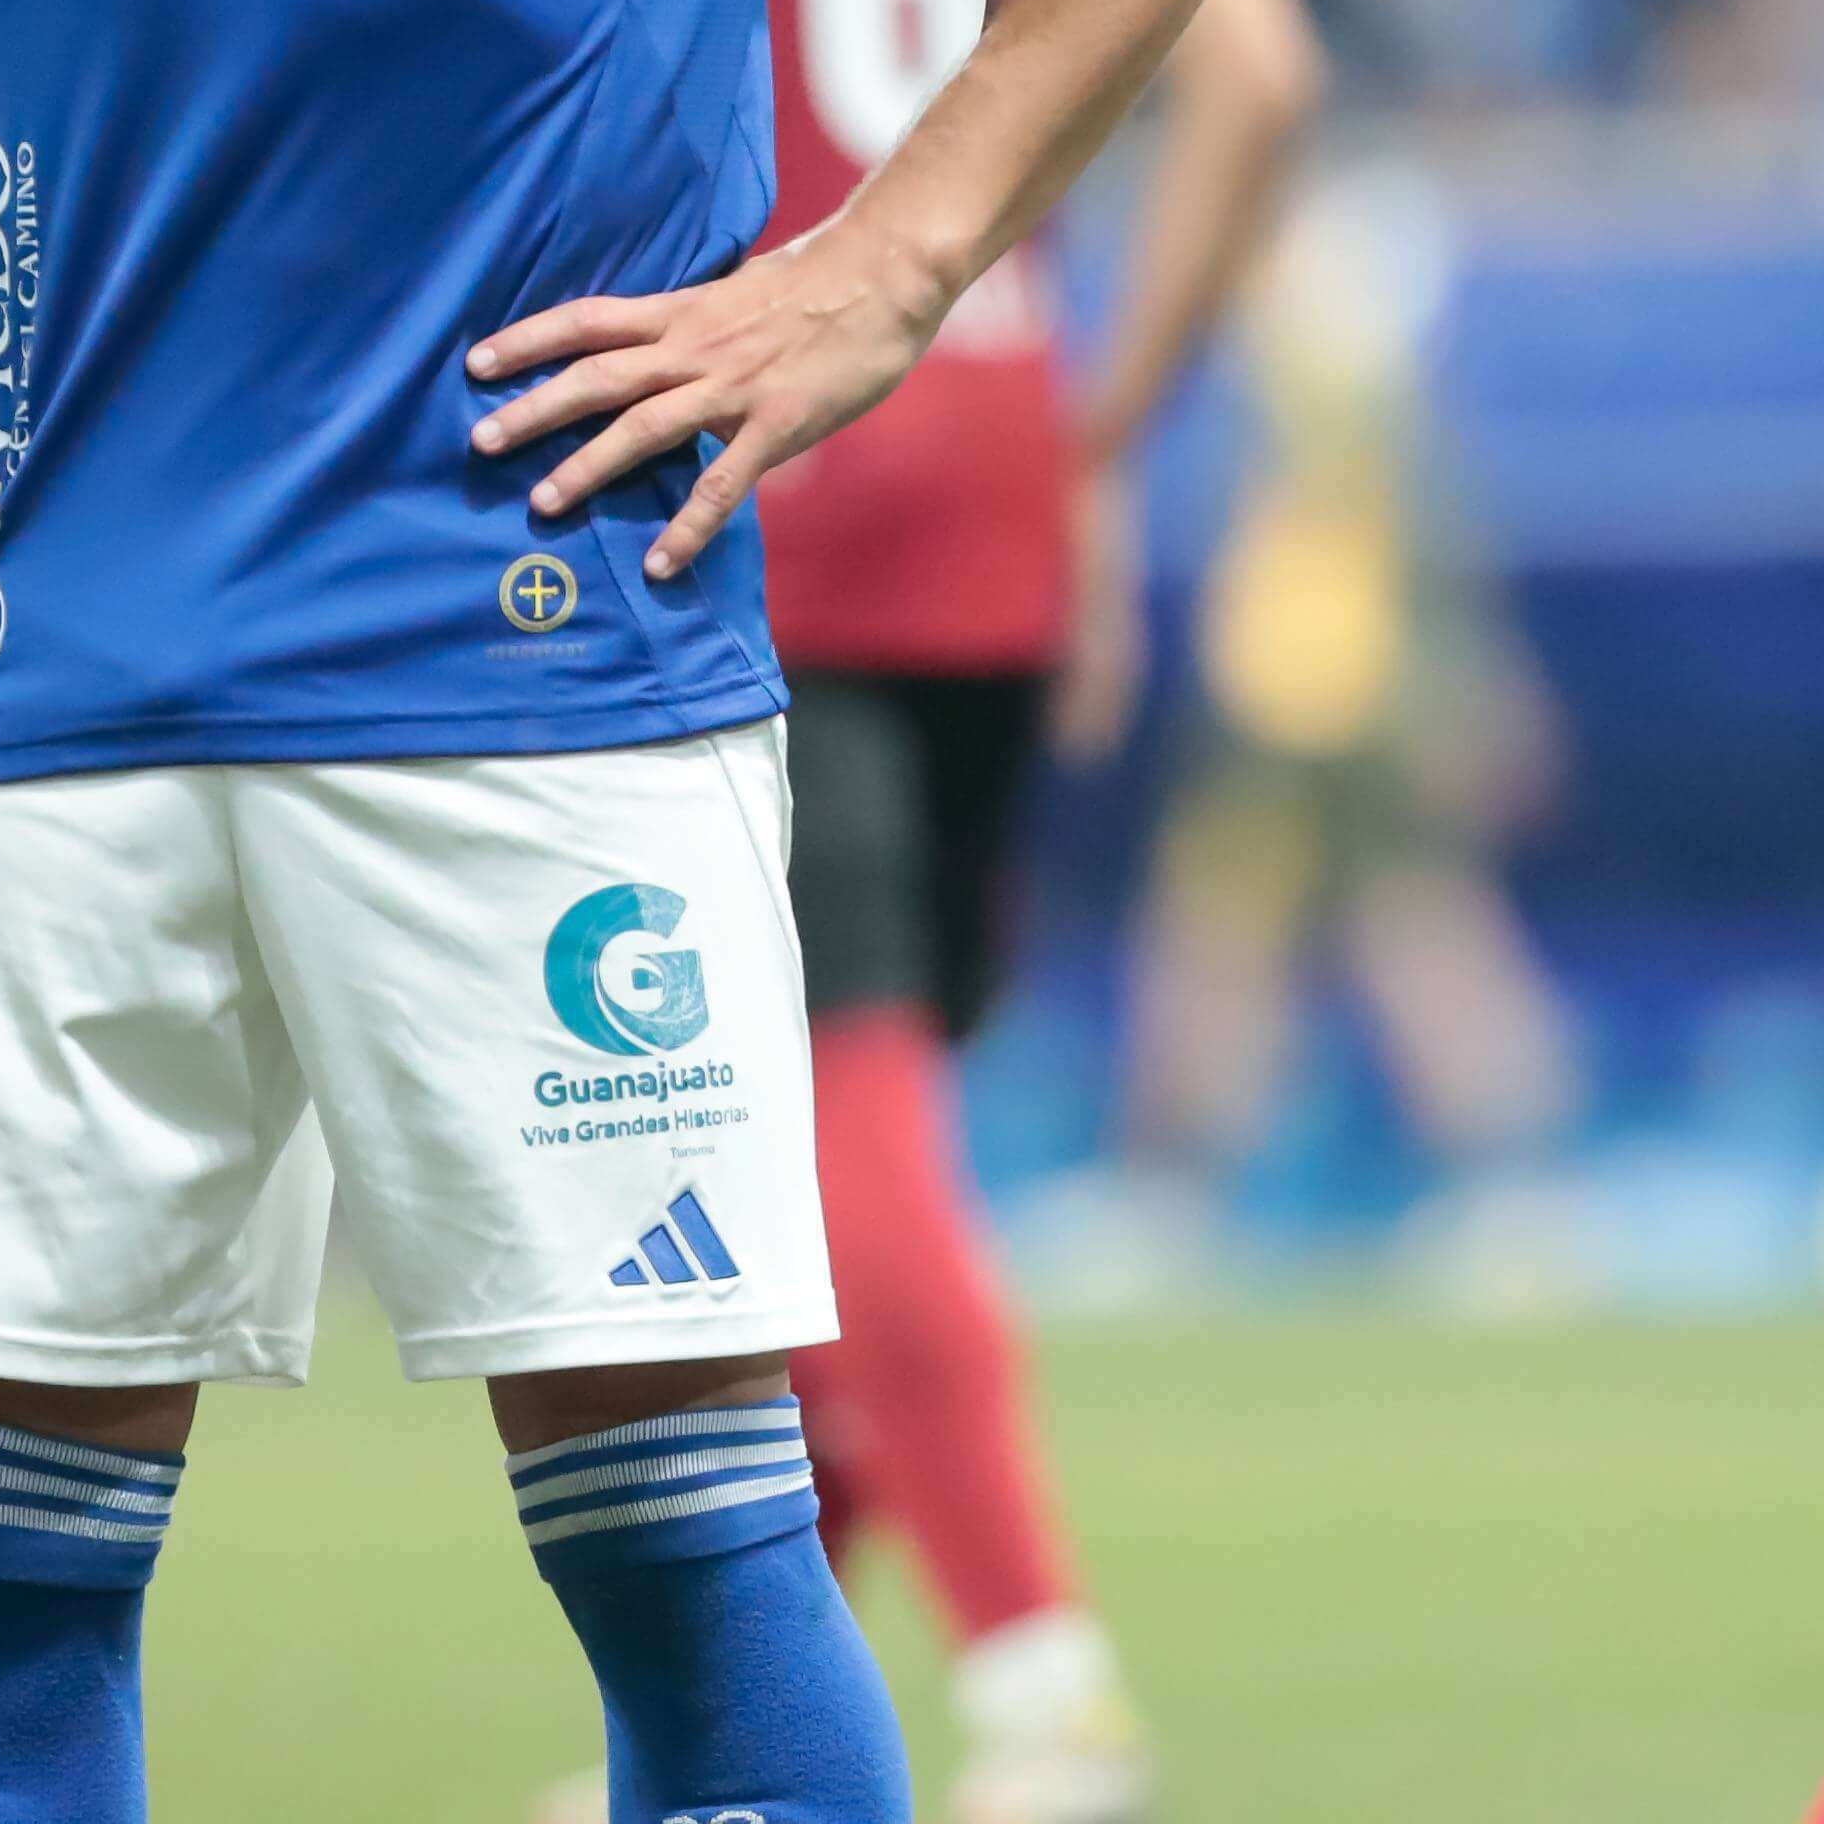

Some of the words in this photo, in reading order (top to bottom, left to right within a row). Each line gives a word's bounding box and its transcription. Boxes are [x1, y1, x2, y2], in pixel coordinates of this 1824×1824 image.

[16, 141, 40, 309] CAMINO
[534, 1059, 734, 1107] Guanajuato
[520, 1126, 570, 1147] Vive
[576, 1114, 670, 1142] Grandes
[674, 1106, 749, 1132] Historias
